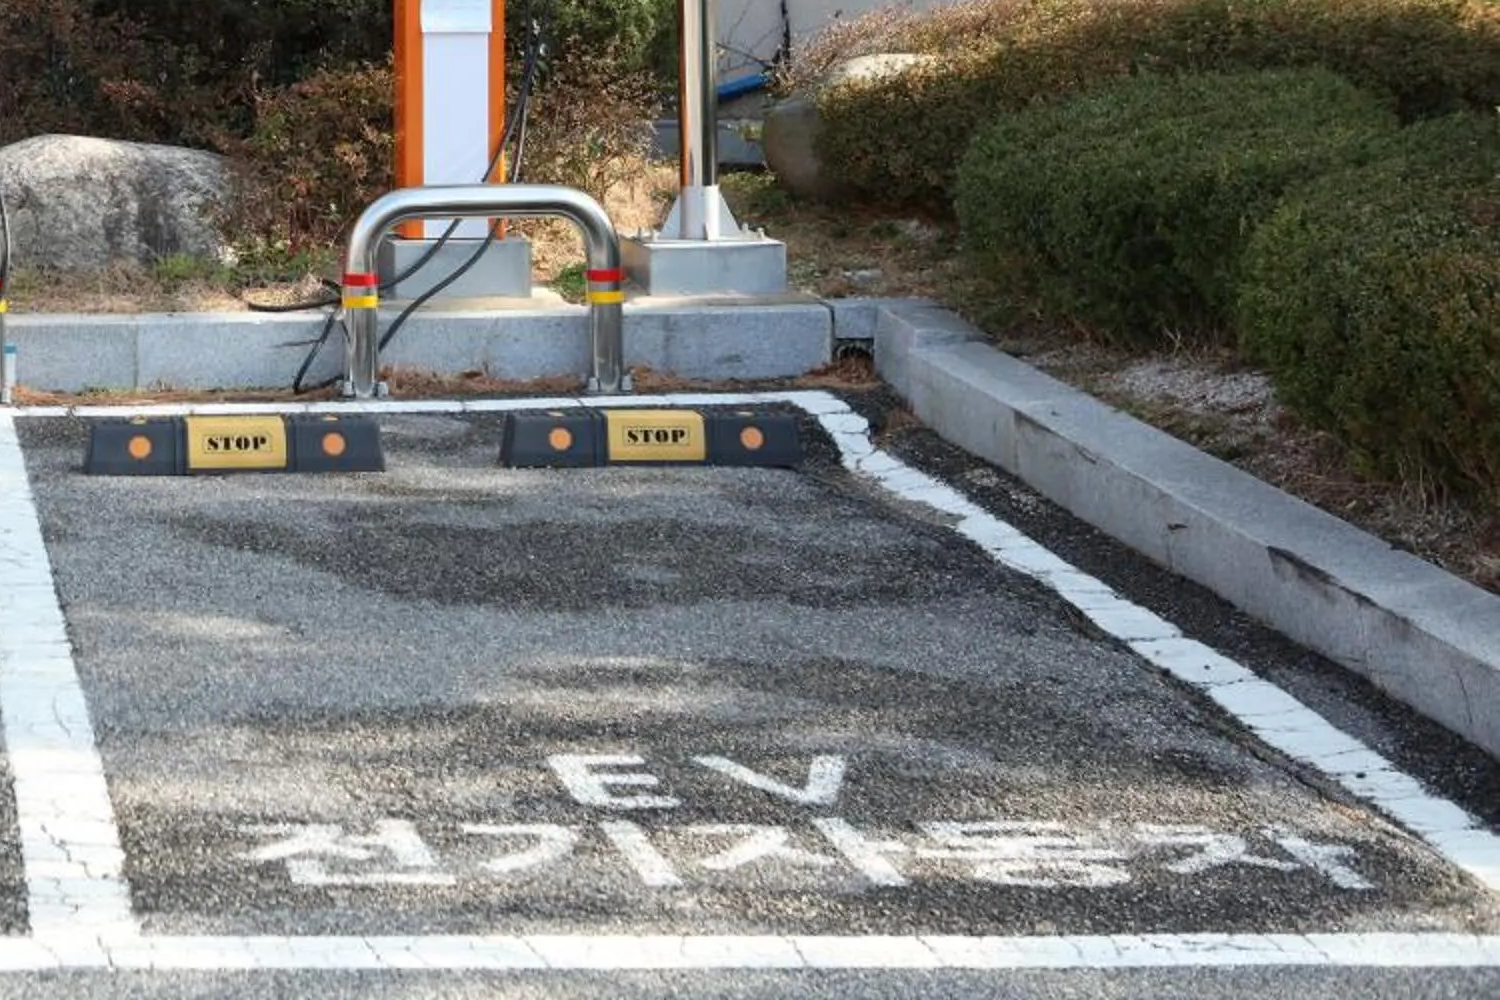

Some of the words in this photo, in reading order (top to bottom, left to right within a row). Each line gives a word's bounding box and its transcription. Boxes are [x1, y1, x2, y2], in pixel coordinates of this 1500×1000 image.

[207, 435, 267, 451] STOP
[627, 428, 686, 444] STOP
[548, 754, 846, 808] EV
[238, 819, 1375, 889] 전기자동차
